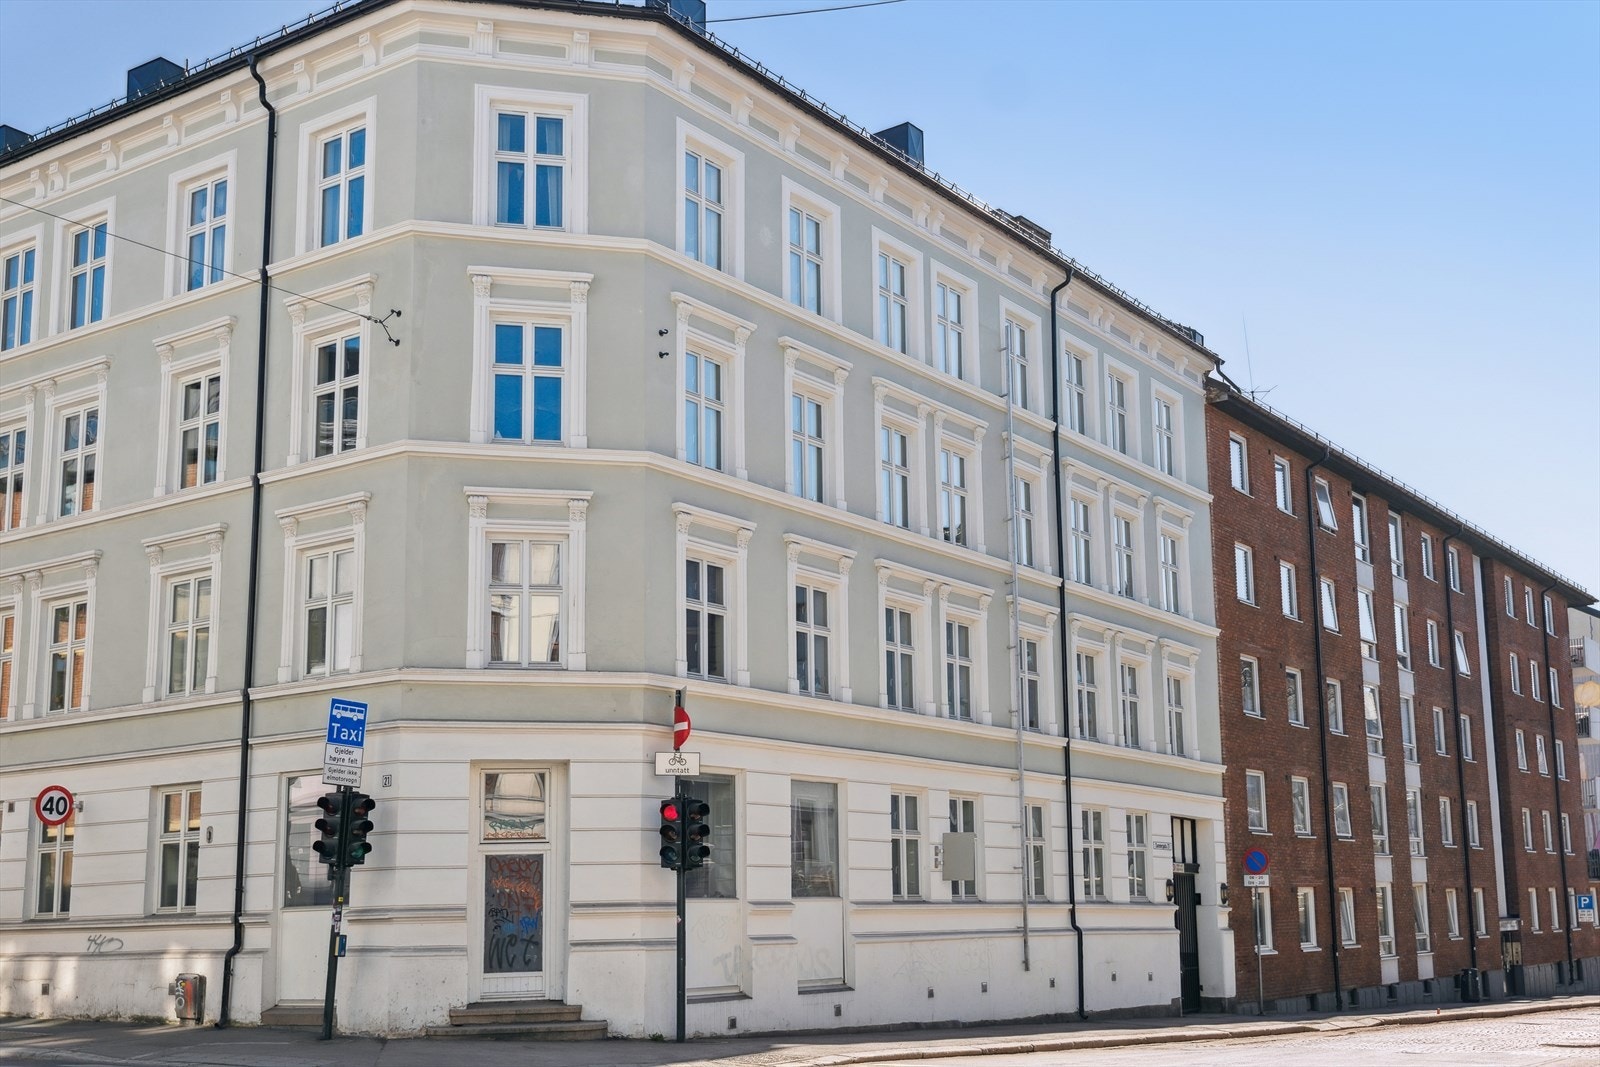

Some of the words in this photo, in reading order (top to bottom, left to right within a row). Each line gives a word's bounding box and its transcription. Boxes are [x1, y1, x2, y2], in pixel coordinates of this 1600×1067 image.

[331, 723, 362, 741] Taxi
[335, 747, 354, 755] Gjelder
[329, 755, 346, 763] høyre
[328, 767, 346, 775] Gjelder
[327, 775, 357, 784] elmotorvogn
[384, 777, 390, 785] 21
[42, 796, 67, 815] 40
[1581, 897, 1589, 907] P
